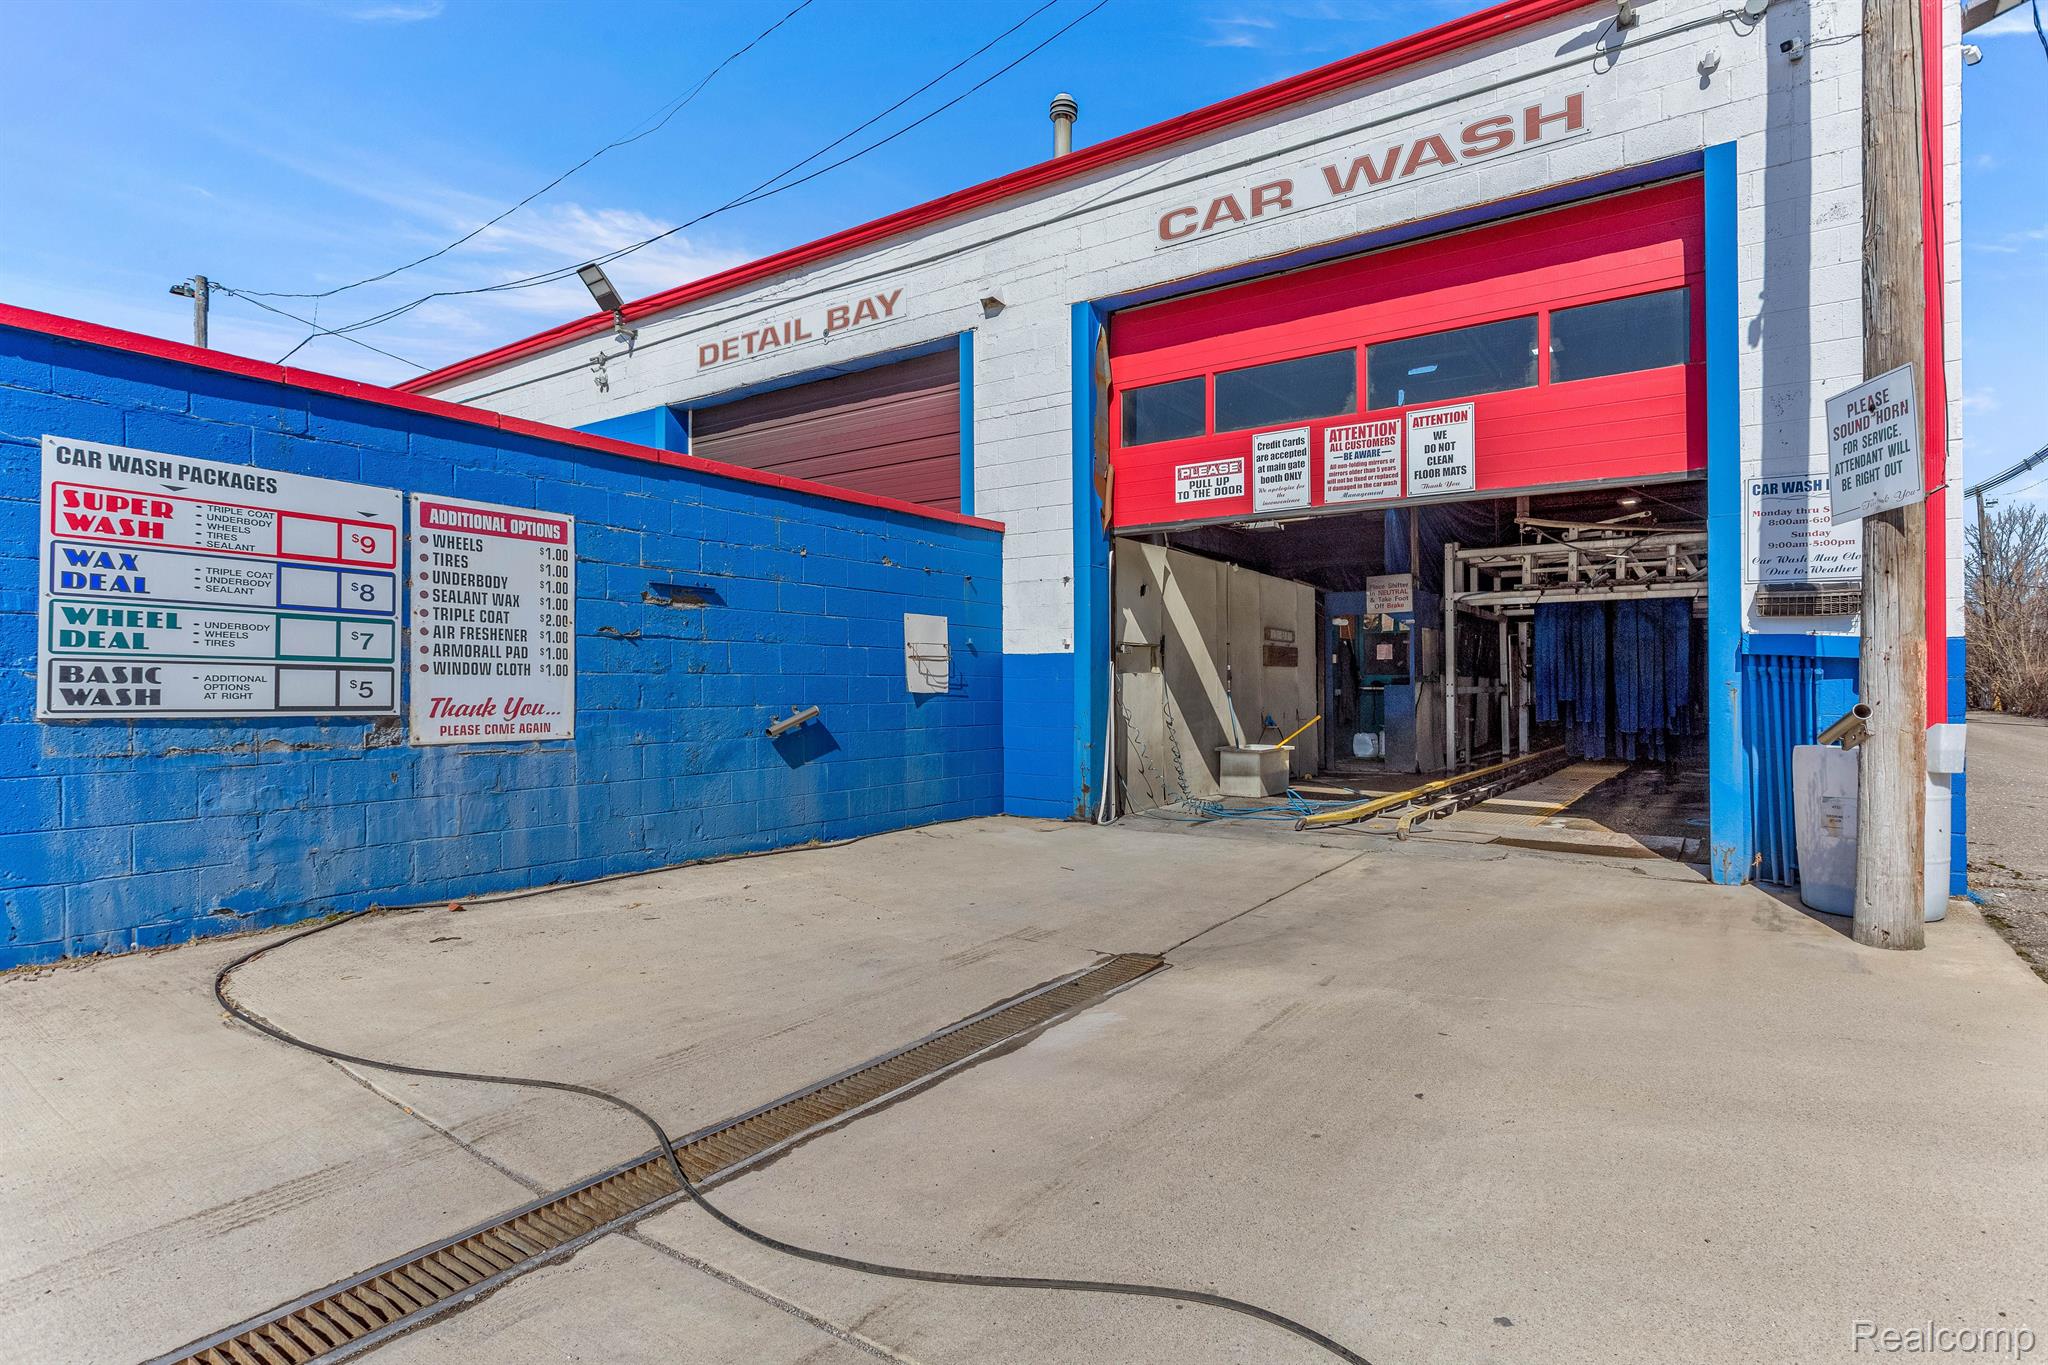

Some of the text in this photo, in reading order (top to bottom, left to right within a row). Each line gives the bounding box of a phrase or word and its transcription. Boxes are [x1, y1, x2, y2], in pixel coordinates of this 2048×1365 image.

[1157, 92, 1584, 241] CAR WASH
[699, 288, 903, 367] DETAIL BAY
[1848, 388, 1889, 418] PLEASE
[1413, 410, 1468, 428] ATTENTION
[1834, 400, 1908, 441] SOUND HORN
[1329, 422, 1396, 443] ATTENTION
[1433, 430, 1447, 440] WE
[1843, 424, 1901, 456] FOR SERVICE.
[1258, 437, 1305, 451] Credit Cards
[1330, 436, 1395, 452] ALL CUSTOMERS
[1425, 442, 1456, 454] DO NOT
[1256, 448, 1307, 462] are accepted
[1344, 449, 1380, 460] BE AWARE
[1427, 454, 1453, 466] CLEAN
[1835, 439, 1910, 476] ATTENDANT WILL
[56, 446, 277, 494] CAR WASH PACKAGES
[1181, 462, 1239, 478] PLEASE
[1258, 461, 1305, 473] at main gate
[1414, 465, 1467, 480] FLOOR MATS
[1190, 477, 1229, 489] PULL UP
[1261, 471, 1302, 484] booth ONLY
[1375, 472, 1398, 480] replaced
[1842, 479, 1852, 491] BE
[1856, 467, 1880, 487] RIGHT
[1885, 460, 1903, 477] OUT
[1177, 485, 1242, 500] TO THE DOOR
[1752, 484, 1778, 496] CAR
[1782, 479, 1822, 493] WASH
[1894, 489, 1915, 502] You
[63, 490, 173, 519] SUPER
[207, 505, 275, 520] TRIPLE COAT
[1752, 508, 1792, 517] Monday
[63, 512, 164, 539] WASH
[207, 514, 272, 528] UNDERBODY
[207, 523, 251, 534] WHEELS
[430, 509, 561, 539] ADDITIONAL OPTIONS
[1768, 516, 1830, 526] 8:00am-6:0
[207, 532, 238, 541] TIRES
[351, 534, 376, 554] $9
[1768, 539, 1855, 549] 9:00am-5:00pm
[207, 540, 255, 552] SEALANT
[433, 534, 568, 561] WHEELS $1.00
[62, 548, 138, 571] WAX
[433, 552, 568, 578] TIRES $1.00
[1752, 552, 1861, 565] Car Wash May Clo
[206, 567, 274, 579] TRIPLE COAT
[1766, 567, 1789, 576] Due
[1810, 565, 1858, 574] Weather
[61, 571, 150, 594] DEAL
[205, 576, 271, 588] UNDERBODY
[205, 585, 254, 595] SEALANT
[432, 571, 568, 594] UNDERBODY $1.00
[351, 582, 375, 602] $8
[432, 589, 568, 611] SEALANT WAX $1.00
[60, 606, 182, 630] WHEEL
[433, 607, 568, 627] TRIPLE COAT $2.00
[204, 622, 270, 632] UNDERBODY
[205, 631, 249, 639] WHEELS
[433, 625, 568, 644] AIR FRESHENER $1.00
[60, 630, 150, 650] DEAL
[204, 639, 235, 647] TIRES
[351, 632, 375, 650] $7
[433, 644, 568, 660] ARMORALL PAD $1.00
[59, 666, 162, 684] BASIC
[433, 662, 568, 677] WINDOW CLOTH $1.00
[204, 675, 267, 683] ADDITIONAL
[204, 683, 250, 691] OPTIONS
[59, 688, 161, 706] WASH
[350, 680, 373, 698] $5
[429, 697, 561, 721] Thank You...
[440, 723, 551, 736] PLEASE COME AGAIN
